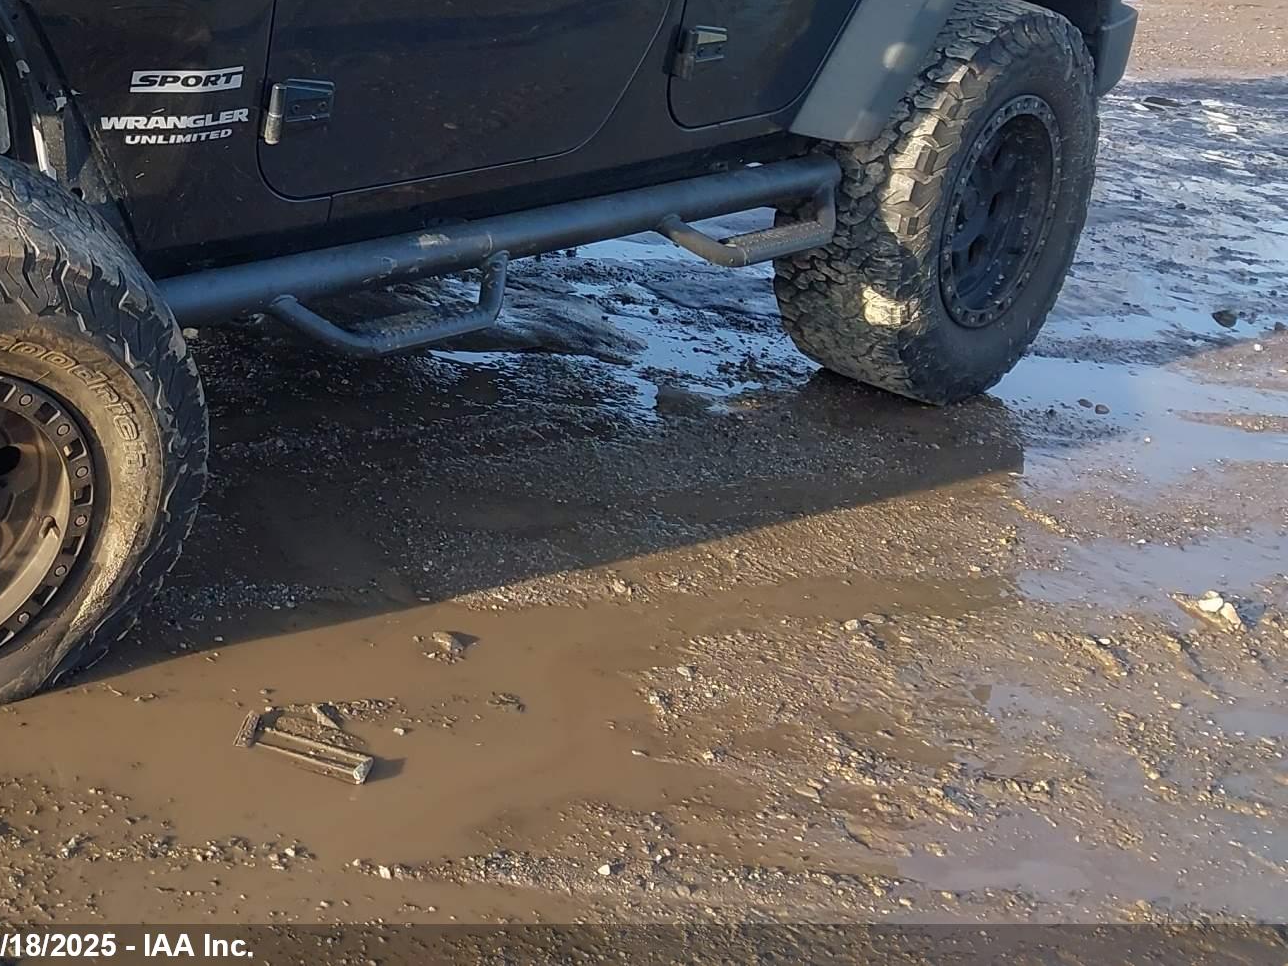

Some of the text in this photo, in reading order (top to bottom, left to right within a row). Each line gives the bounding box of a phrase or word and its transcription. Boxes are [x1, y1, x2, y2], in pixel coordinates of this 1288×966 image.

[132, 71, 244, 89] SPORT
[100, 107, 249, 130] WRANGLER
[125, 128, 233, 145] UNLIMITED
